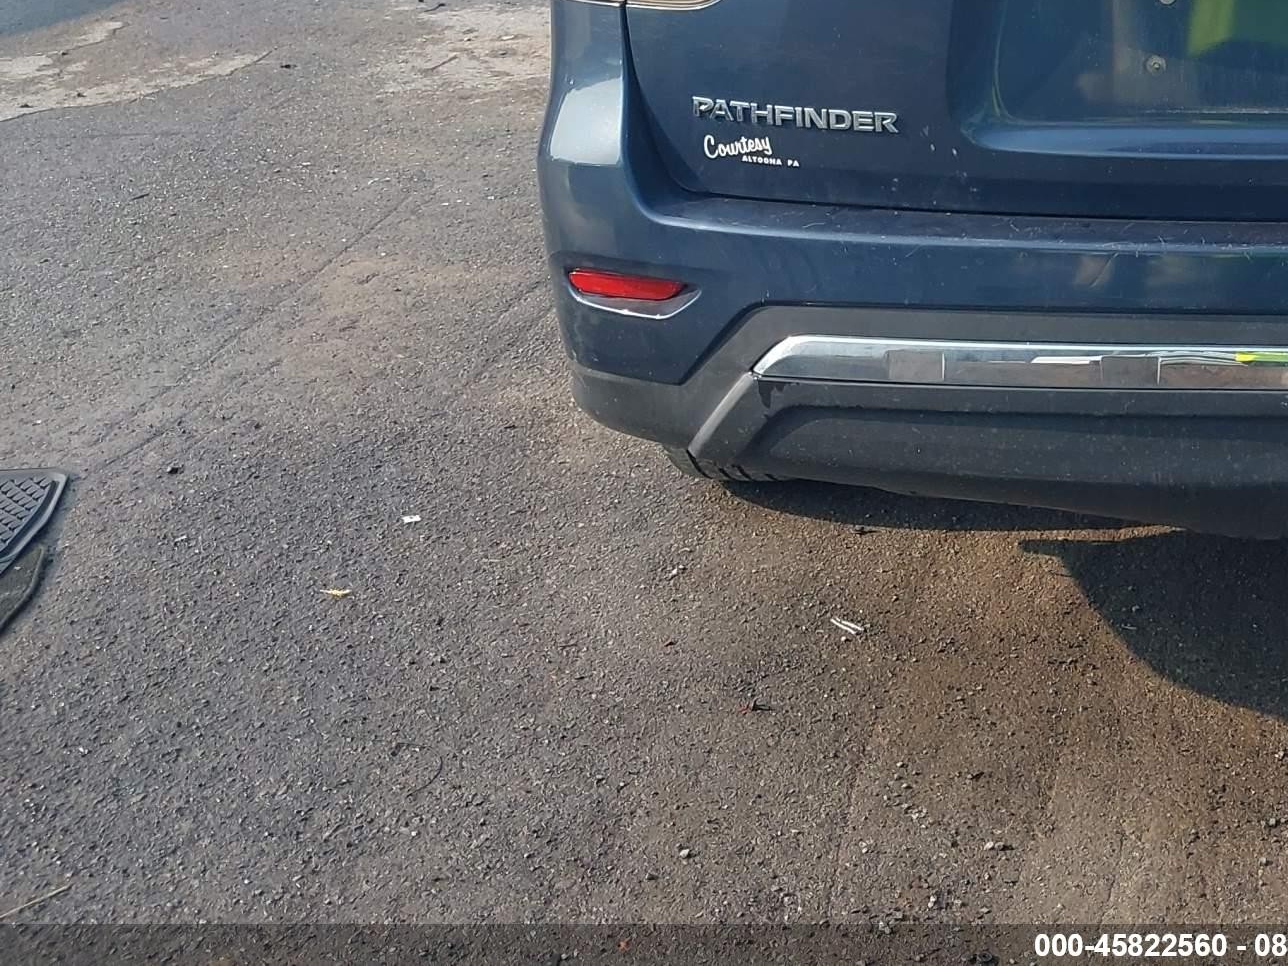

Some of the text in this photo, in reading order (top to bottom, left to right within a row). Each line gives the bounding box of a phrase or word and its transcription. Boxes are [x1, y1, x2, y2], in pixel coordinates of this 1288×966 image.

[691, 95, 899, 134] PATHFINDER
[703, 134, 773, 159] Courtesy
[741, 155, 800, 167] ALTOONA PA
